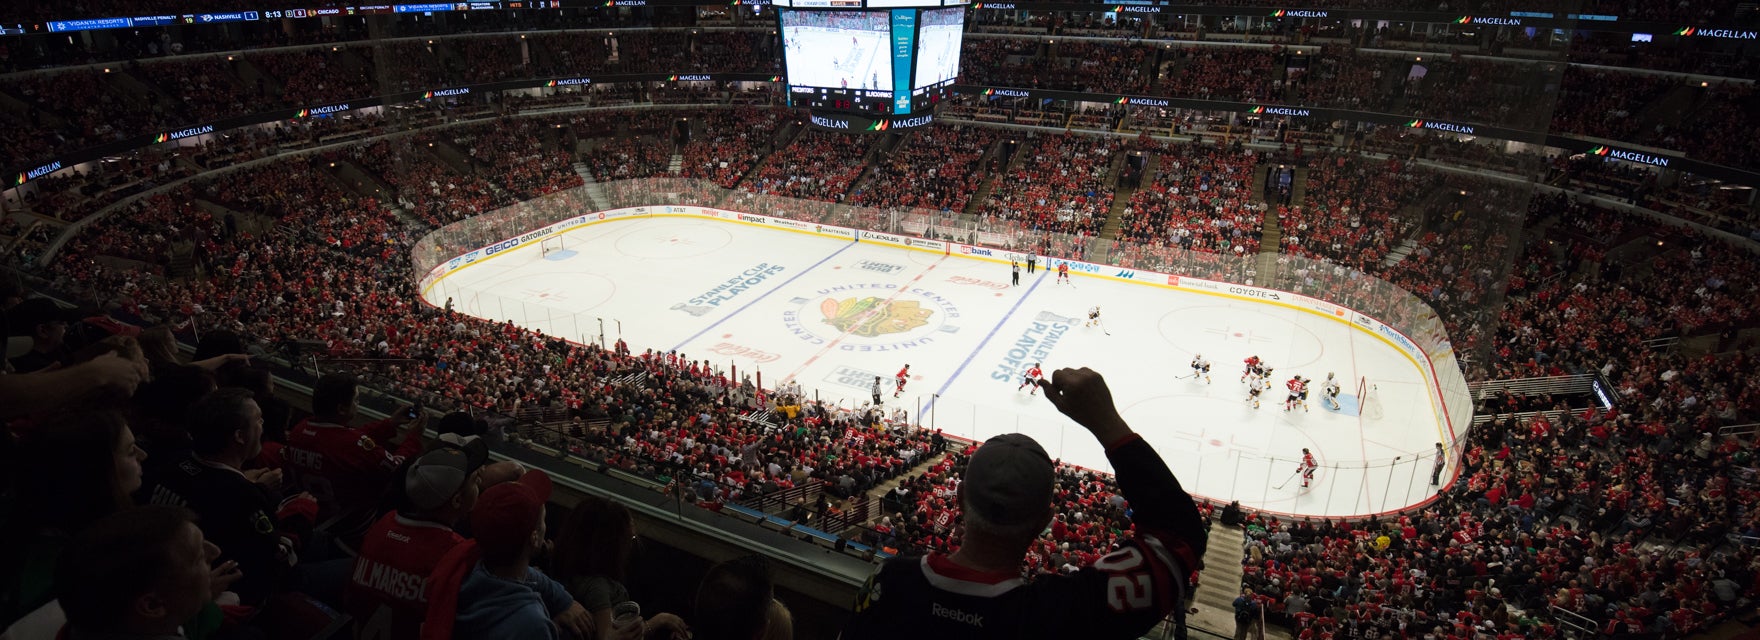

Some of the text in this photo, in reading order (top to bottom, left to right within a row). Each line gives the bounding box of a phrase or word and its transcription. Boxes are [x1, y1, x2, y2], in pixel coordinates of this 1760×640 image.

[1473, 17, 1521, 26] MAGELLAN
[1697, 29, 1757, 40] MAGELLAN
[557, 78, 590, 86] MAGELLAN
[434, 88, 469, 97] MAGELLAN
[995, 89, 1029, 97] MAGELLAN
[1130, 98, 1169, 106] MAGELLAN
[310, 103, 349, 115] MAGELLAN
[1266, 107, 1310, 116] MAGELLAN
[892, 114, 933, 128] MAGELLAN
[1425, 121, 1473, 134] MAGELLAN
[171, 125, 213, 139] MAGELLAN
[1611, 150, 1669, 167] MAGELLAN
[28, 161, 62, 179] MAGELLAN
[702, 209, 719, 217] meijer
[742, 214, 765, 223] impact
[558, 219, 579, 229] UNITED
[774, 219, 807, 228] WeatherTech
[521, 226, 553, 243] GATORADE
[871, 234, 900, 243] LEXUS
[485, 238, 519, 255] GEICO
[689, 262, 769, 305] STANLEY CUP
[707, 264, 785, 306] PLAYOFFS
[1229, 286, 1267, 298] COYOTE
[817, 283, 961, 318] UNITED CENTER
[783, 310, 934, 352] UNITED CENTER
[1031, 322, 1069, 363] STANLEY
[991, 321, 1048, 382] PLAYOFFS
[937, 511, 949, 526] 19
[932, 602, 983, 628] Reebok
